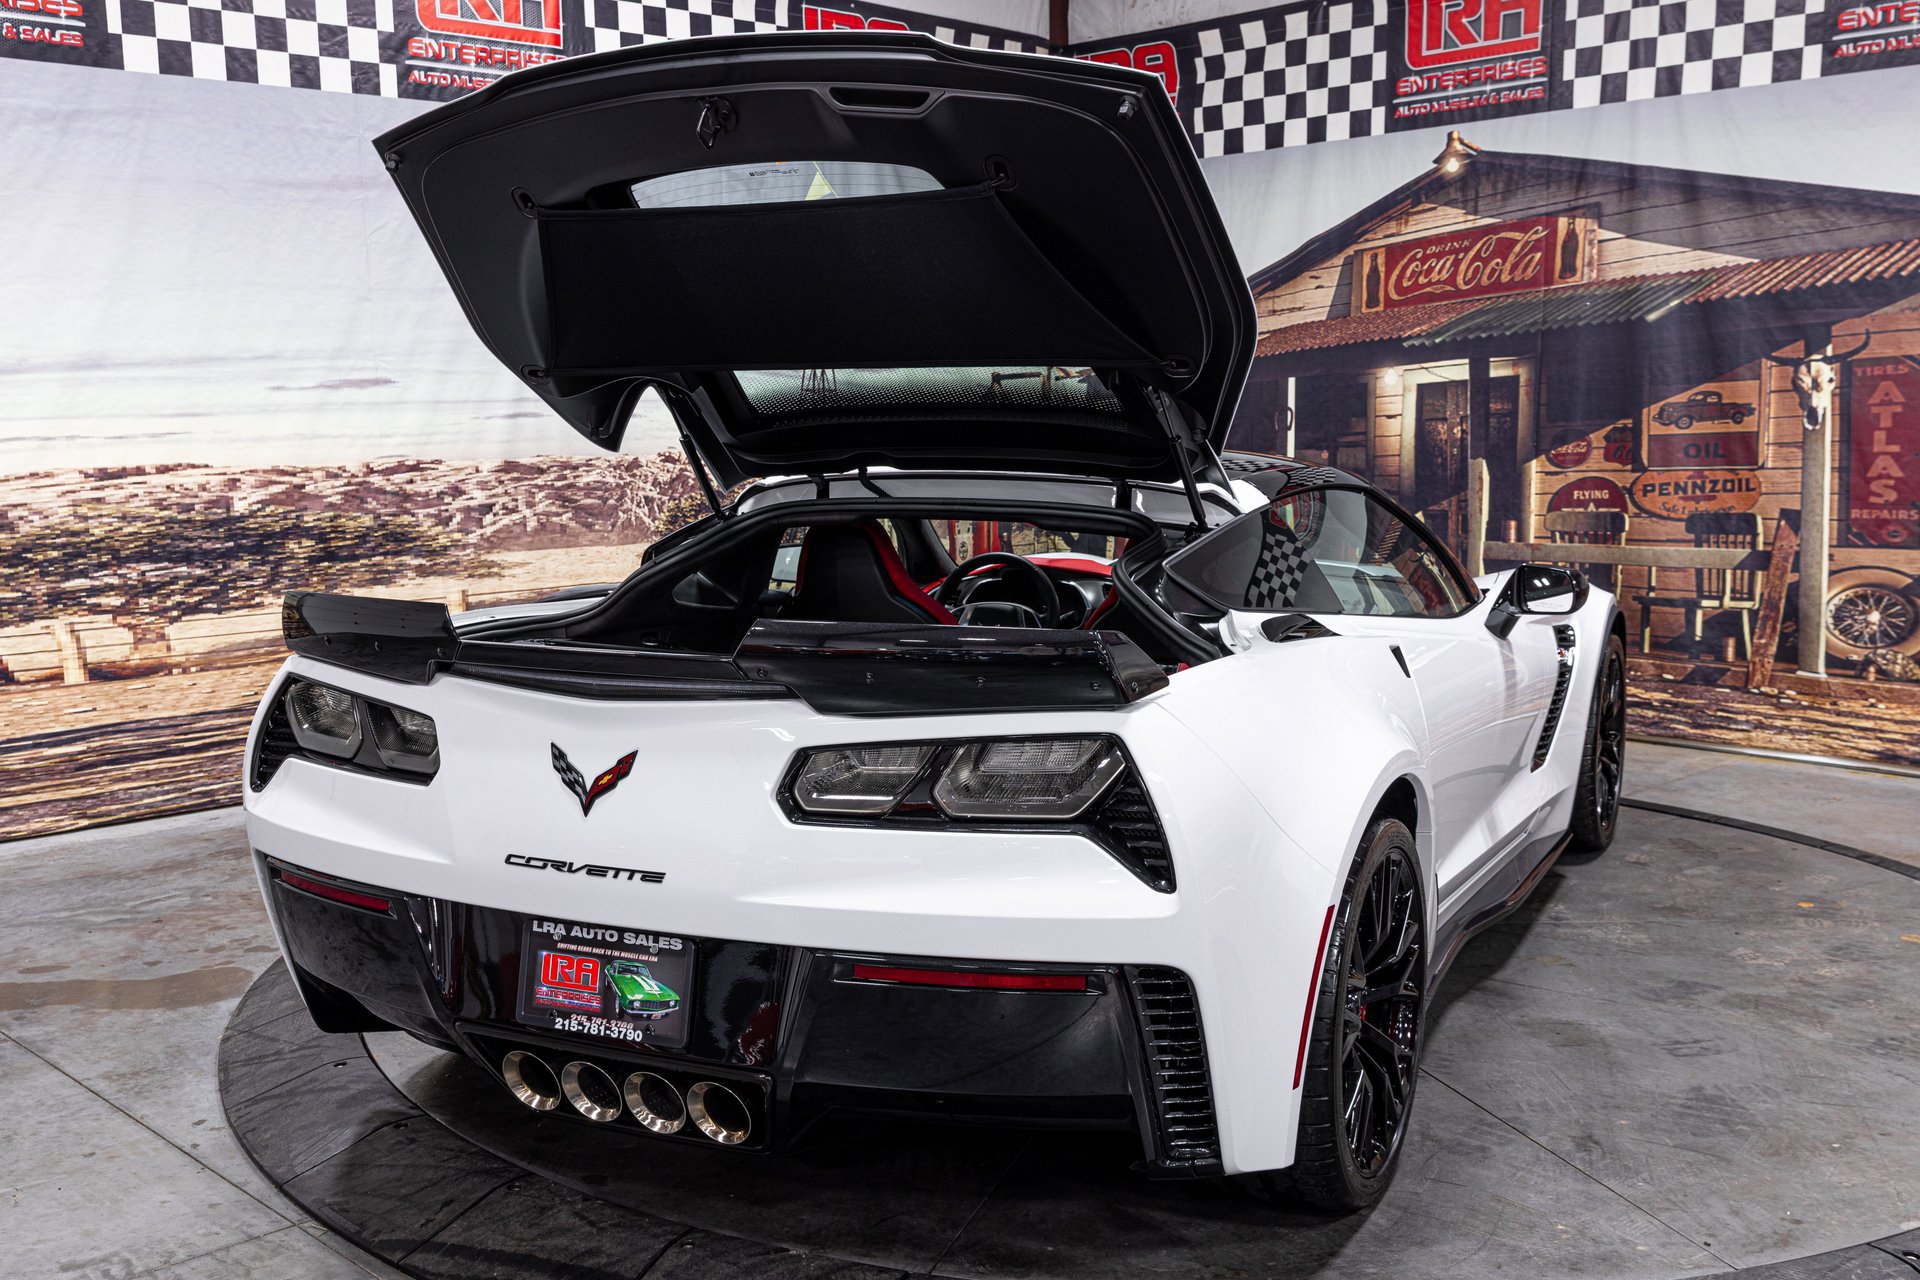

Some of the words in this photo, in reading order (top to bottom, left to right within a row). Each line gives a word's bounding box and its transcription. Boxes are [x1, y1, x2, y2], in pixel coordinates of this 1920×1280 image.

[3, 22, 17, 39] &
[20, 25, 84, 47] SALES
[1833, 39, 1885, 58] AUTO
[408, 70, 450, 87] AUTO
[1395, 56, 1548, 95] ENTERPRISES
[1393, 102, 1431, 118] AUTO
[1431, 95, 1488, 114] MUSEUM
[1488, 92, 1499, 106] &
[1500, 86, 1545, 104] SALES
[1426, 238, 1473, 256] DRINK
[1855, 364, 1910, 377] TIRES
[1683, 443, 1727, 459] OIL
[1866, 380, 1906, 504] ATLAS
[1573, 489, 1609, 500] FLYING
[1642, 477, 1757, 497] PENNZOIL
[1851, 508, 1920, 521] REPAIRS
[504, 853, 667, 884] CORVETTE
[533, 920, 566, 936] LRA
[570, 926, 619, 942] AUTO
[623, 932, 683, 950] SALES
[557, 943, 578, 951] SHIFTING
[578, 945, 592, 953] GEARS
[612, 949, 620, 957] THE
[620, 951, 639, 959] MUSCLE
[541, 952, 600, 993] LRA
[535, 987, 602, 1006] ENTERPRISES
[554, 1018, 643, 1042] 215-781-3790
